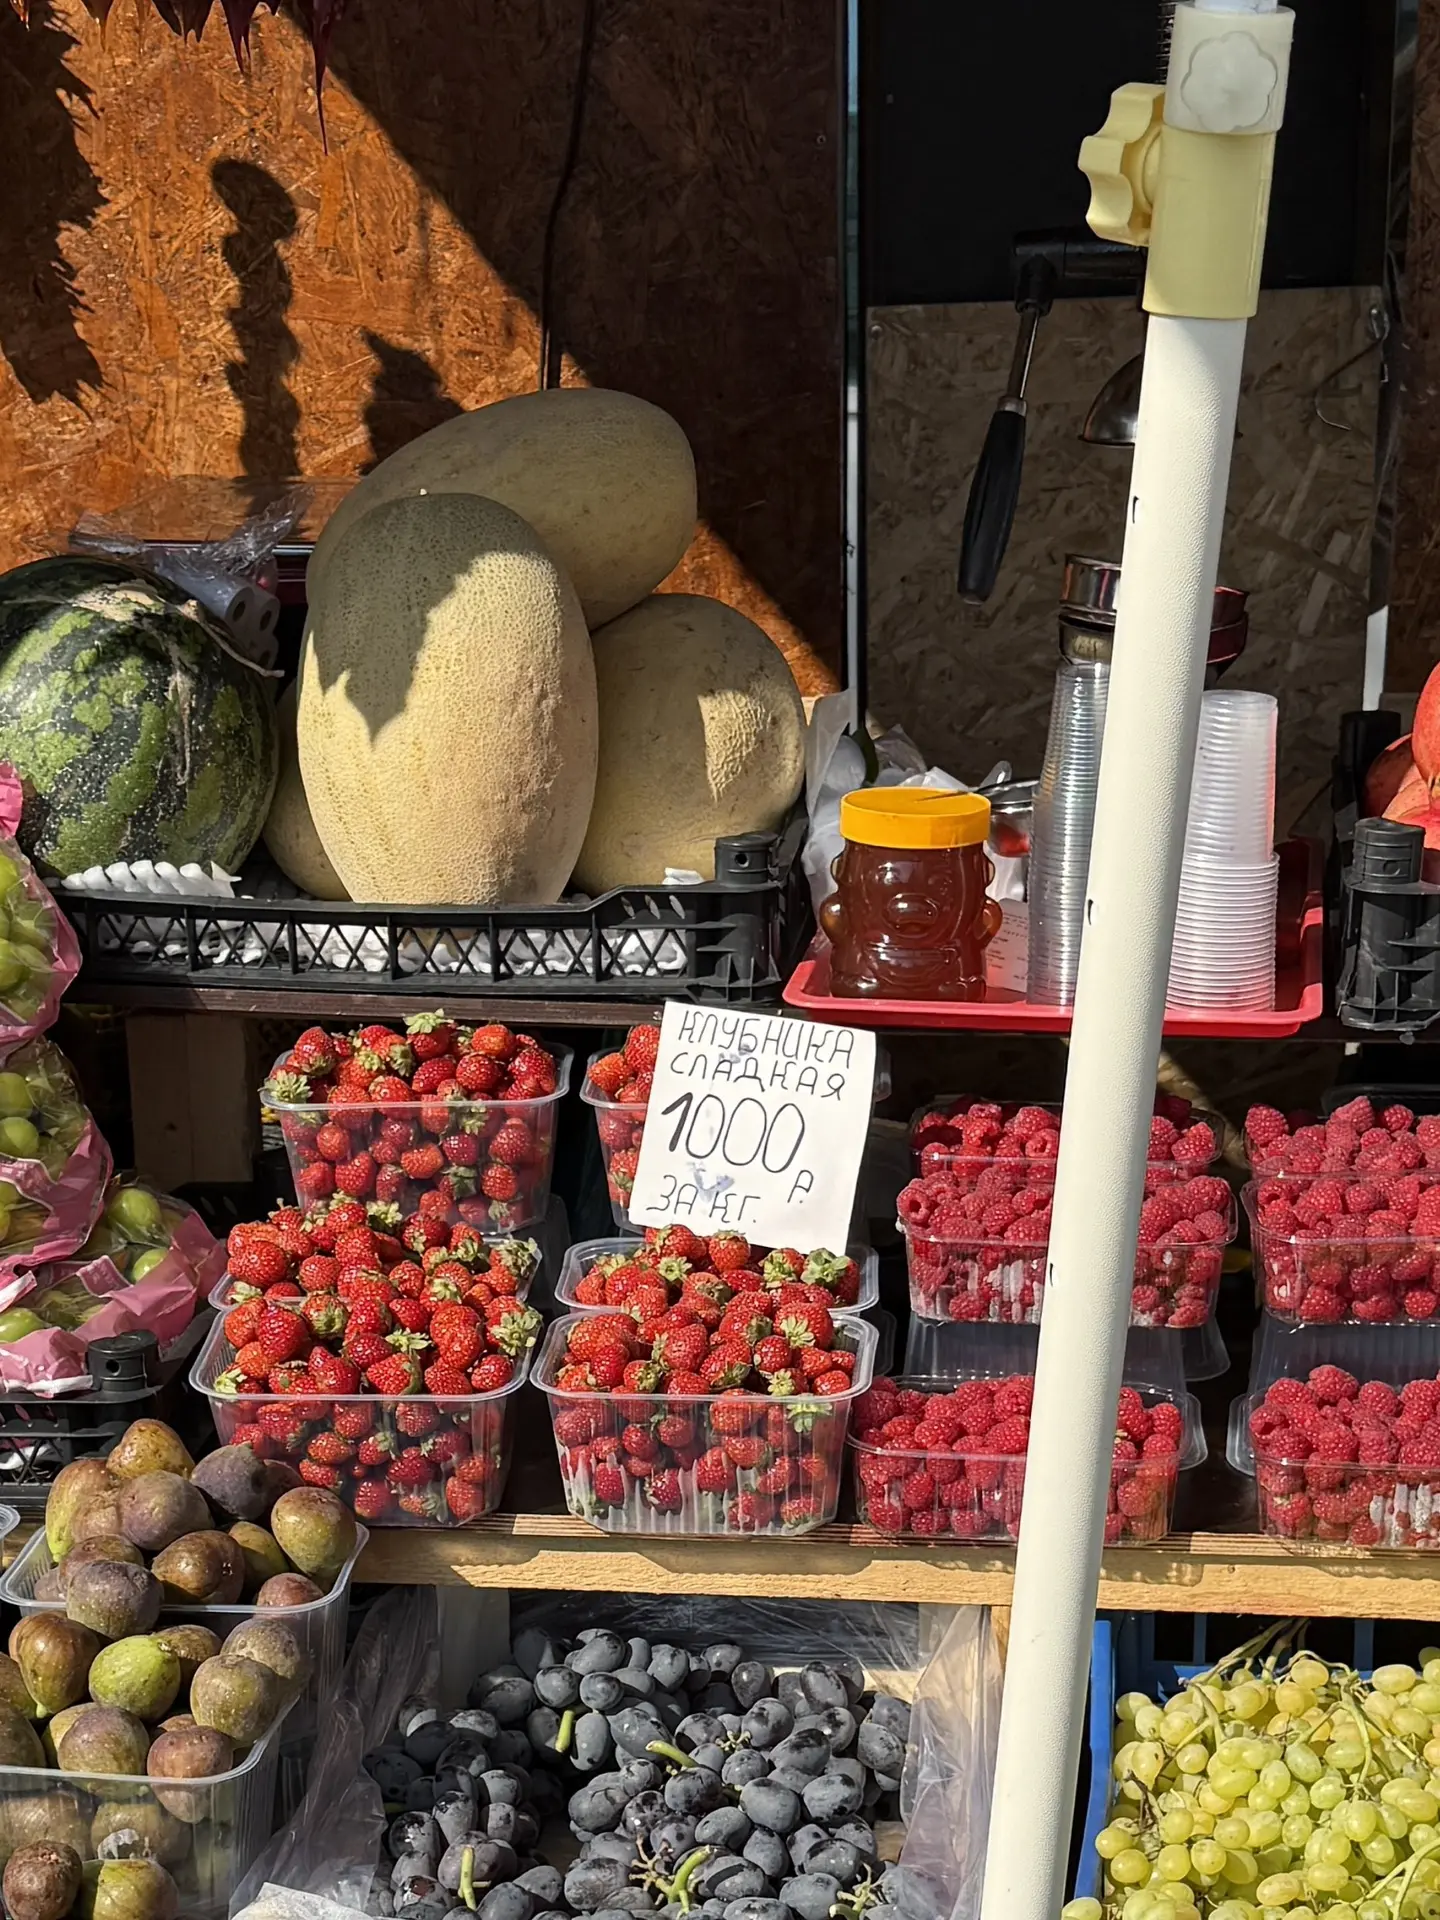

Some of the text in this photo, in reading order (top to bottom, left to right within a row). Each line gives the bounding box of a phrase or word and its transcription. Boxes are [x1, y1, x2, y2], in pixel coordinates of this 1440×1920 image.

[678, 1010, 855, 1069] КЛУБНИКА
[670, 1052, 845, 1101] СЛАДКАЯ
[661, 1092, 805, 1173] 1000
[646, 1174, 699, 1215] ЗА
